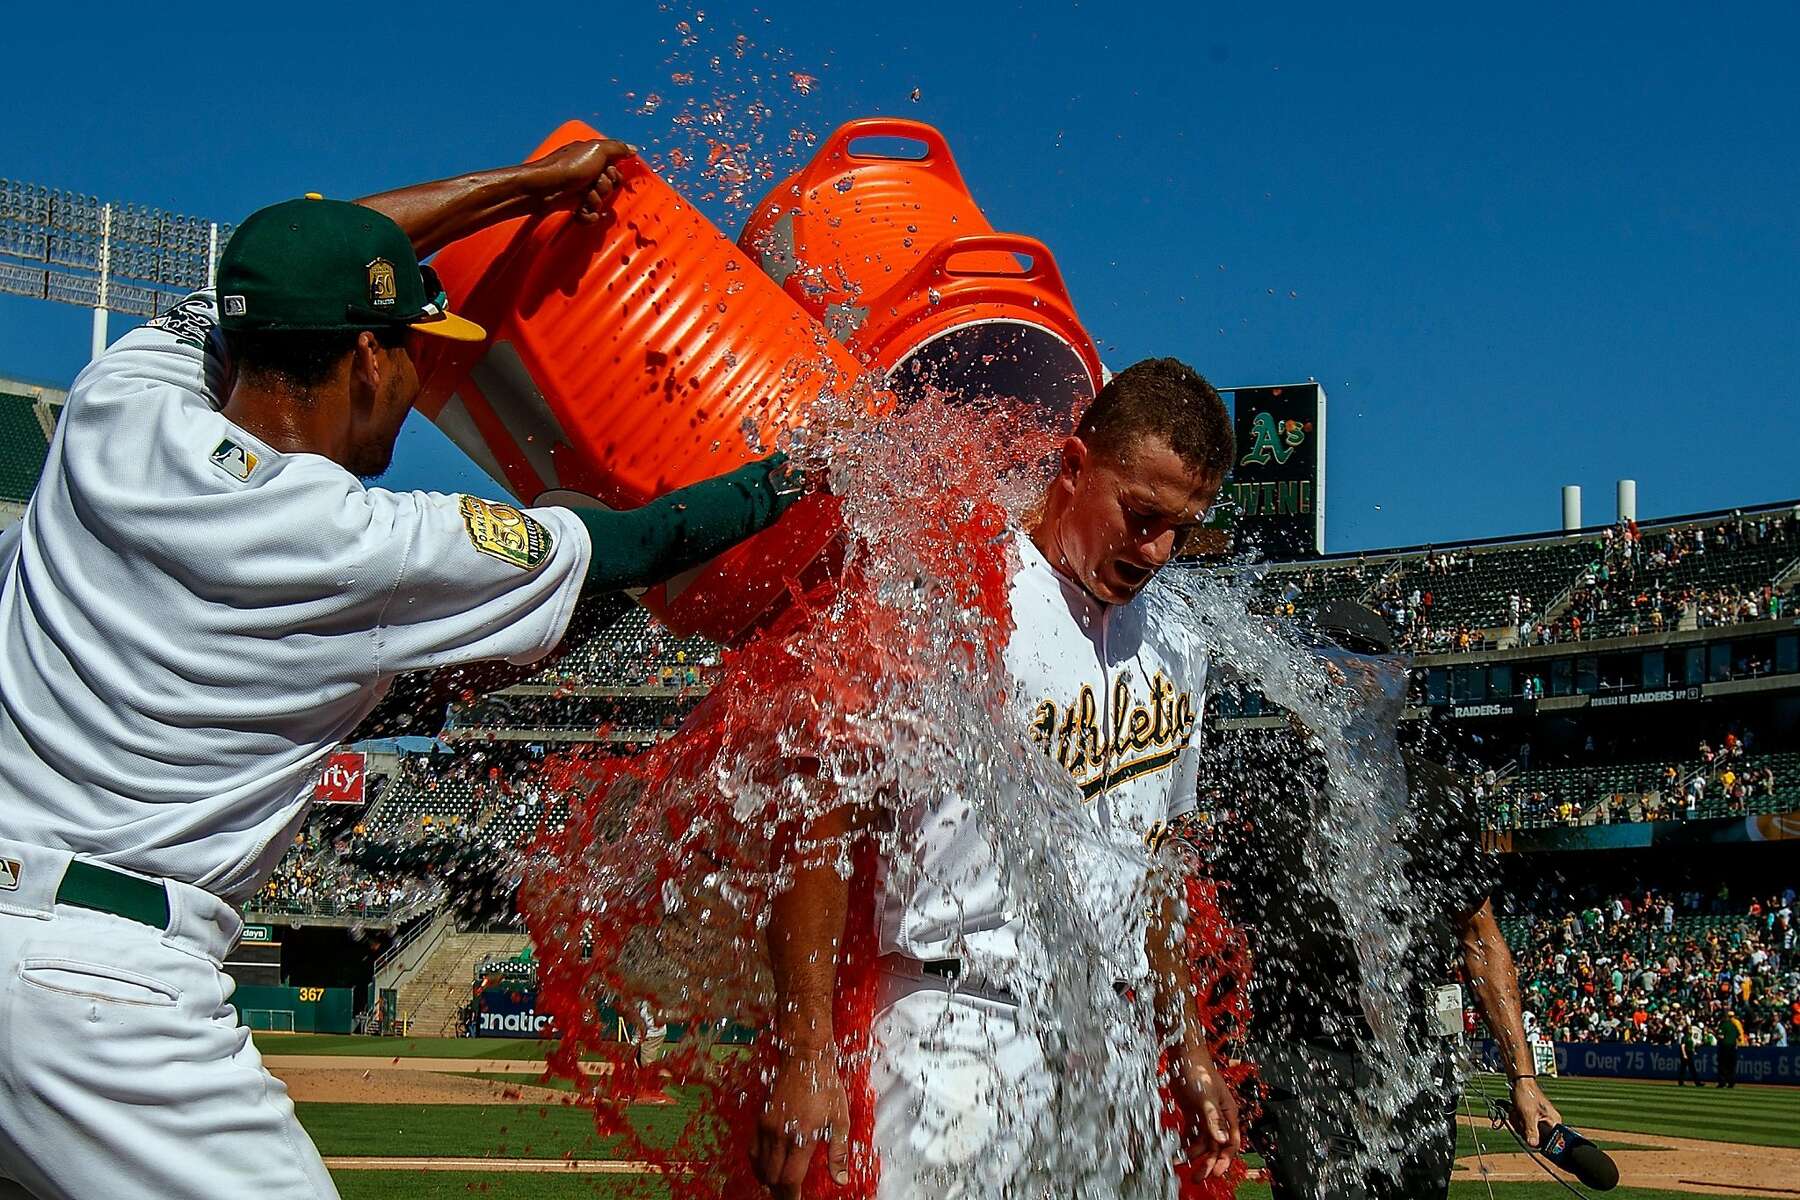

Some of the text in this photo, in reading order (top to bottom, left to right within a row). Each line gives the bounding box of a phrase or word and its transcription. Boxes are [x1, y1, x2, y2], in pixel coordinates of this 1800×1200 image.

[375, 273, 394, 296] 50
[1240, 411, 1304, 465] A's
[487, 505, 525, 551] 50
[1630, 690, 1674, 704] RAIDERS
[300, 987, 325, 1002] 367
[1585, 1050, 1621, 1072] Over
[1625, 1051, 1645, 1070] 75
[1694, 1053, 1708, 1073] of
[1712, 1054, 1772, 1080] Sings
[1778, 1056, 1790, 1076] &
